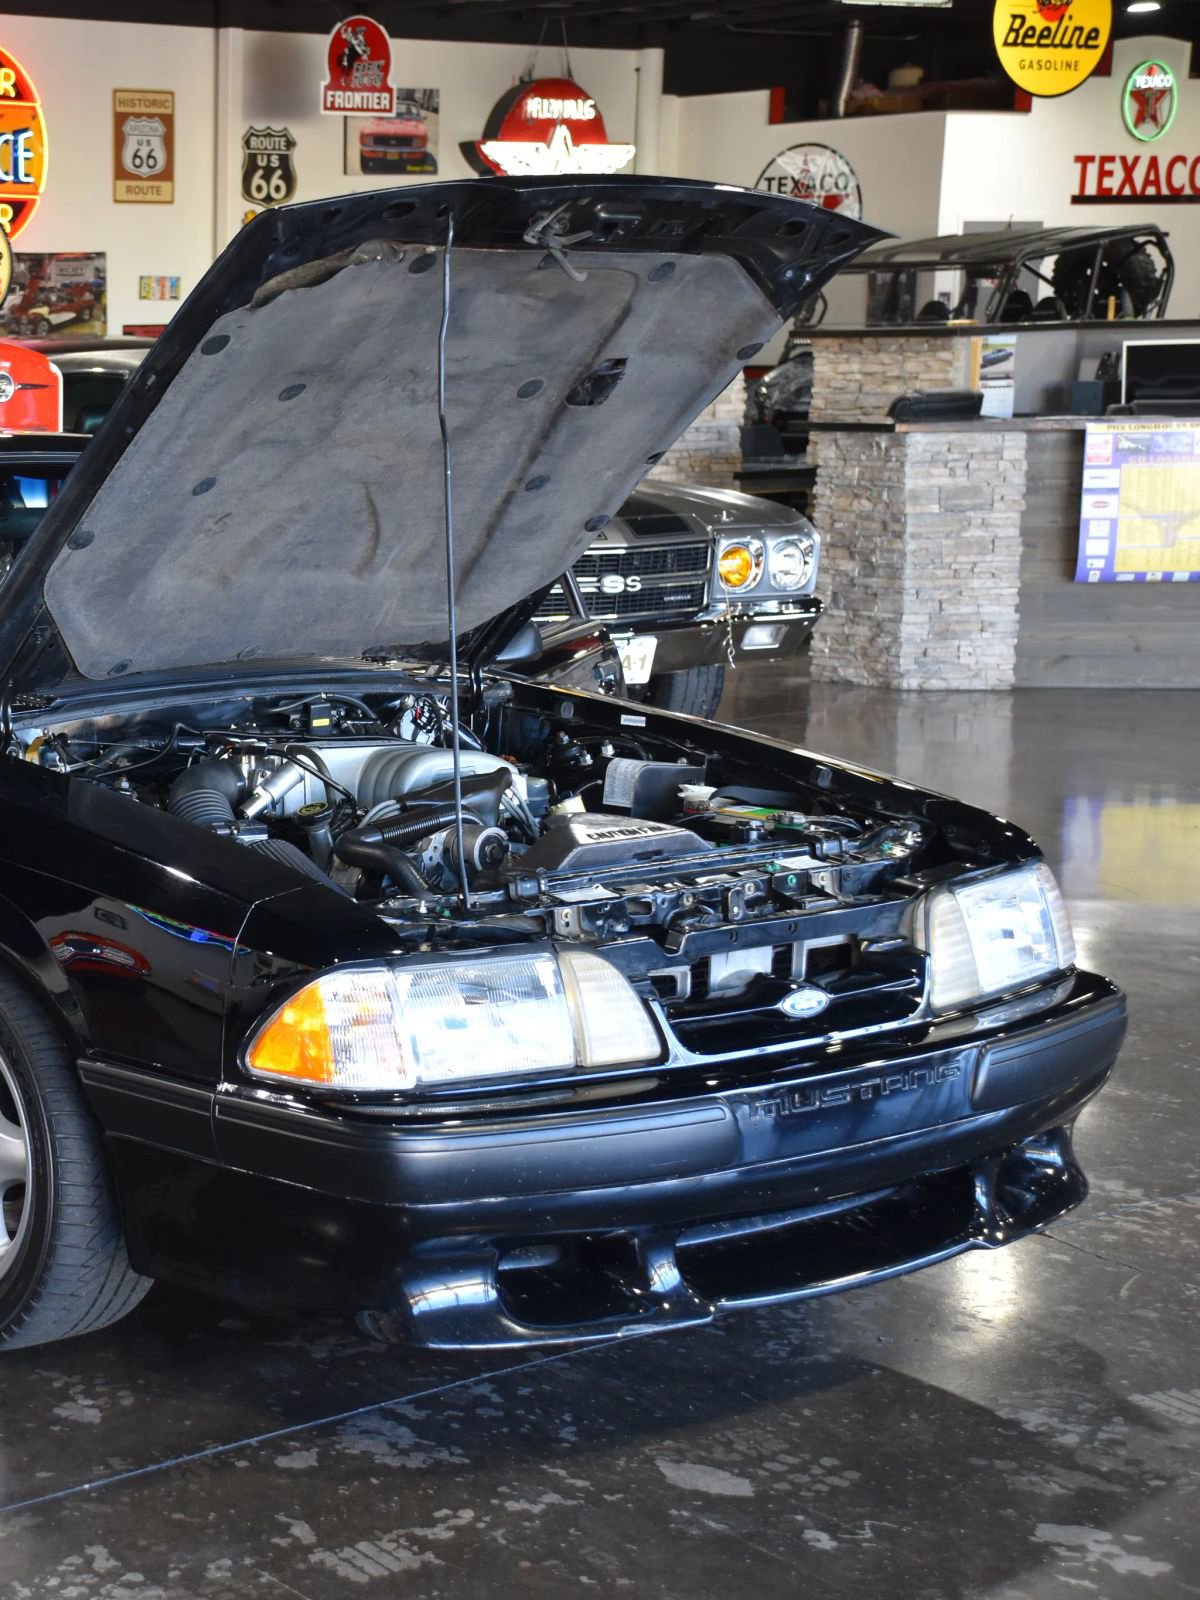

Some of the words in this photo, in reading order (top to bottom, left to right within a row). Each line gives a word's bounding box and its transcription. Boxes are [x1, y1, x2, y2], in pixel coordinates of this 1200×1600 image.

[1002, 14, 1100, 49] Beeline
[1019, 59, 1080, 71] GASOLINE
[1135, 74, 1173, 88] TEXACO
[118, 98, 170, 109] HISTORIC
[326, 91, 390, 110] FRONTIER
[250, 136, 287, 150] ROUTE
[132, 149, 158, 169] 66
[126, 185, 162, 196] ROUTE
[251, 170, 287, 200] 66
[764, 172, 850, 194] TEXACO
[587, 828, 638, 841] CAUTION
[751, 1065, 961, 1119] MUSTANG
